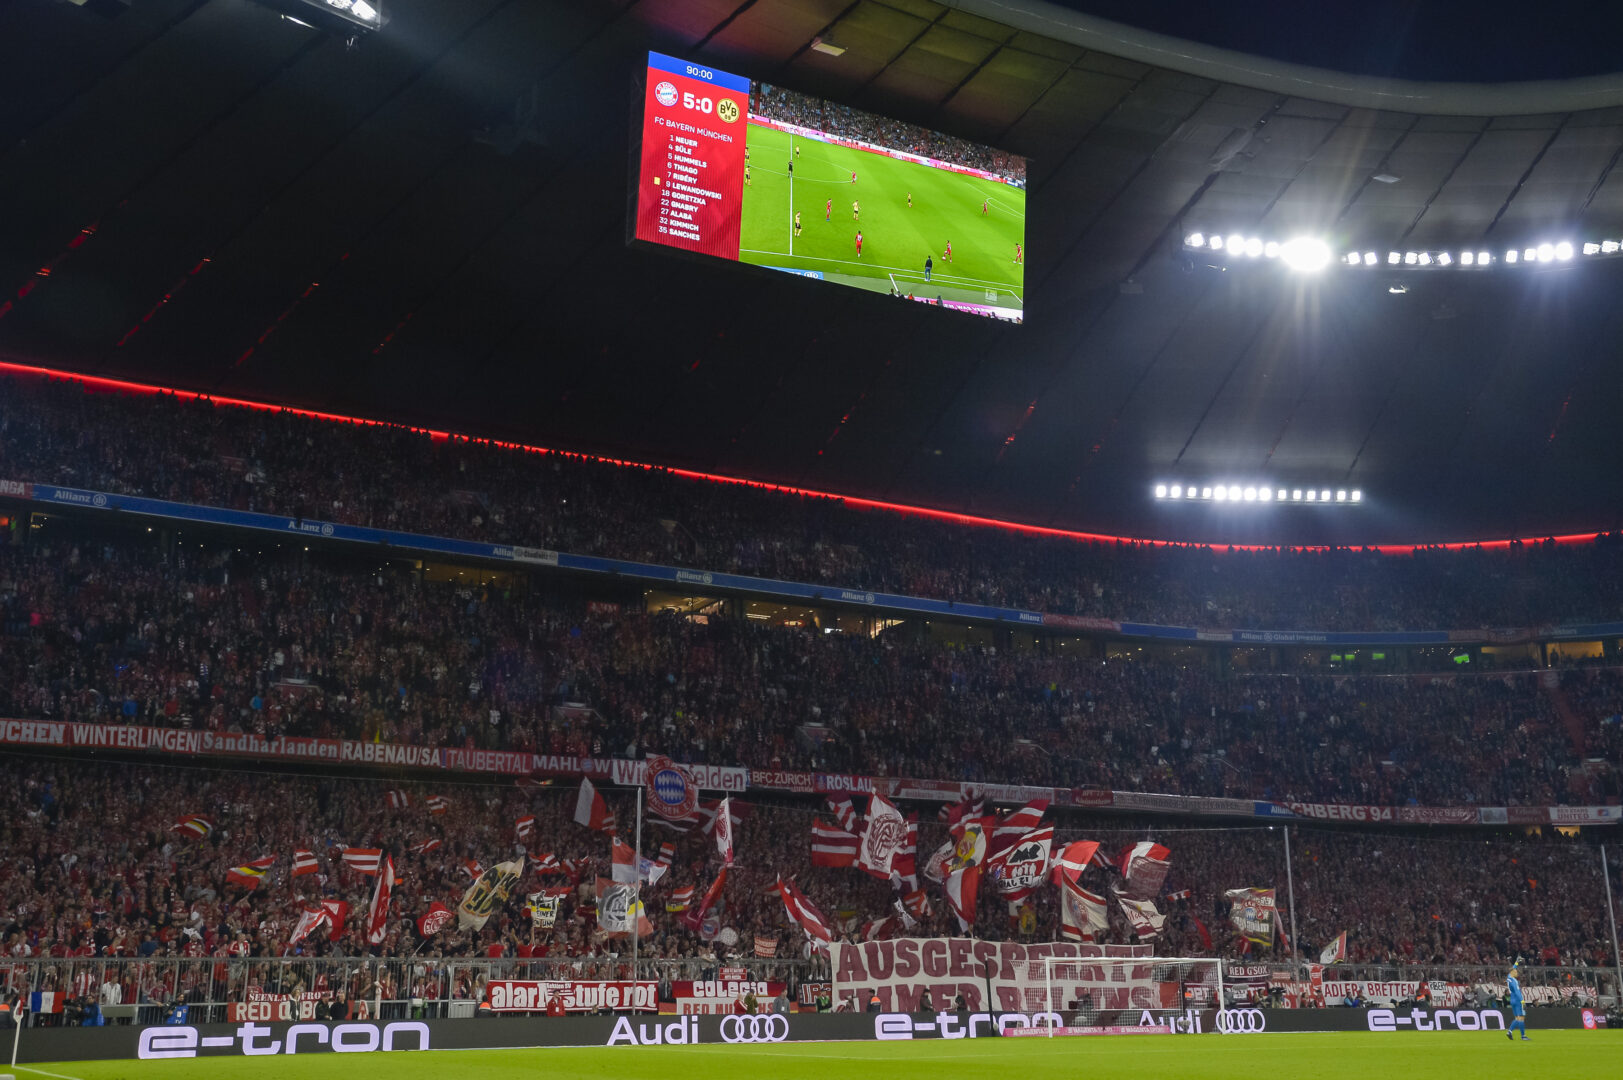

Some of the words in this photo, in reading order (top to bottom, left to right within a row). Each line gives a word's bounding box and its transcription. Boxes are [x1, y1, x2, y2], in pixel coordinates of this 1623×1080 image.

[686, 65, 713, 80] 90:00
[683, 92, 713, 114] 5:0
[720, 101, 737, 117] BVB
[654, 116, 665, 126] FC
[666, 119, 696, 134] BAYERN
[696, 128, 733, 143] MÜNCHEN
[670, 134, 674, 142] 1
[675, 135, 698, 148] NEUER
[674, 144, 692, 155] SÜLE
[674, 154, 708, 168] HUMMELS
[673, 163, 698, 175] THIAGO
[672, 172, 698, 184] RIBÉRY
[662, 189, 670, 197] 18
[671, 191, 706, 206] GORETZKA
[672, 182, 722, 200] LEWANDOWSKI
[660, 198, 670, 206] 22
[670, 200, 698, 213] GNABRY
[670, 210, 693, 221] ALABA
[659, 216, 668, 225] 32
[670, 219, 700, 232] KIMMICH
[658, 226, 668, 234] 35
[668, 228, 700, 241] SANCHES
[54, 490, 91, 503] Allianz
[676, 570, 702, 581] Allianz
[841, 591, 865, 601] Allianz
[1020, 612, 1040, 622] Allianz
[1241, 632, 1263, 641] Allianz
[1274, 632, 1296, 641] Global
[1296, 634, 1327, 642] Investors
[71, 723, 199, 752] WINTERLINGEN
[203, 731, 338, 759] Sandharlanden
[341, 741, 440, 768] RABENAU/SA
[449, 752, 530, 773] TAUBERTAL
[752, 771, 773, 784] BFC
[774, 771, 812, 787] ZÜRICH
[826, 774, 872, 793] RÖSLAU
[1229, 966, 1245, 975] RED
[623, 984, 656, 1007] rot
[1324, 984, 1358, 998] ADLER
[1368, 983, 1415, 997] BRETTEN
[236, 1002, 271, 1020] RED
[683, 1003, 710, 1014] RED
[1367, 1008, 1506, 1032] e-tron
[606, 1015, 699, 1046] Audi
[138, 1022, 430, 1060] e-tron
